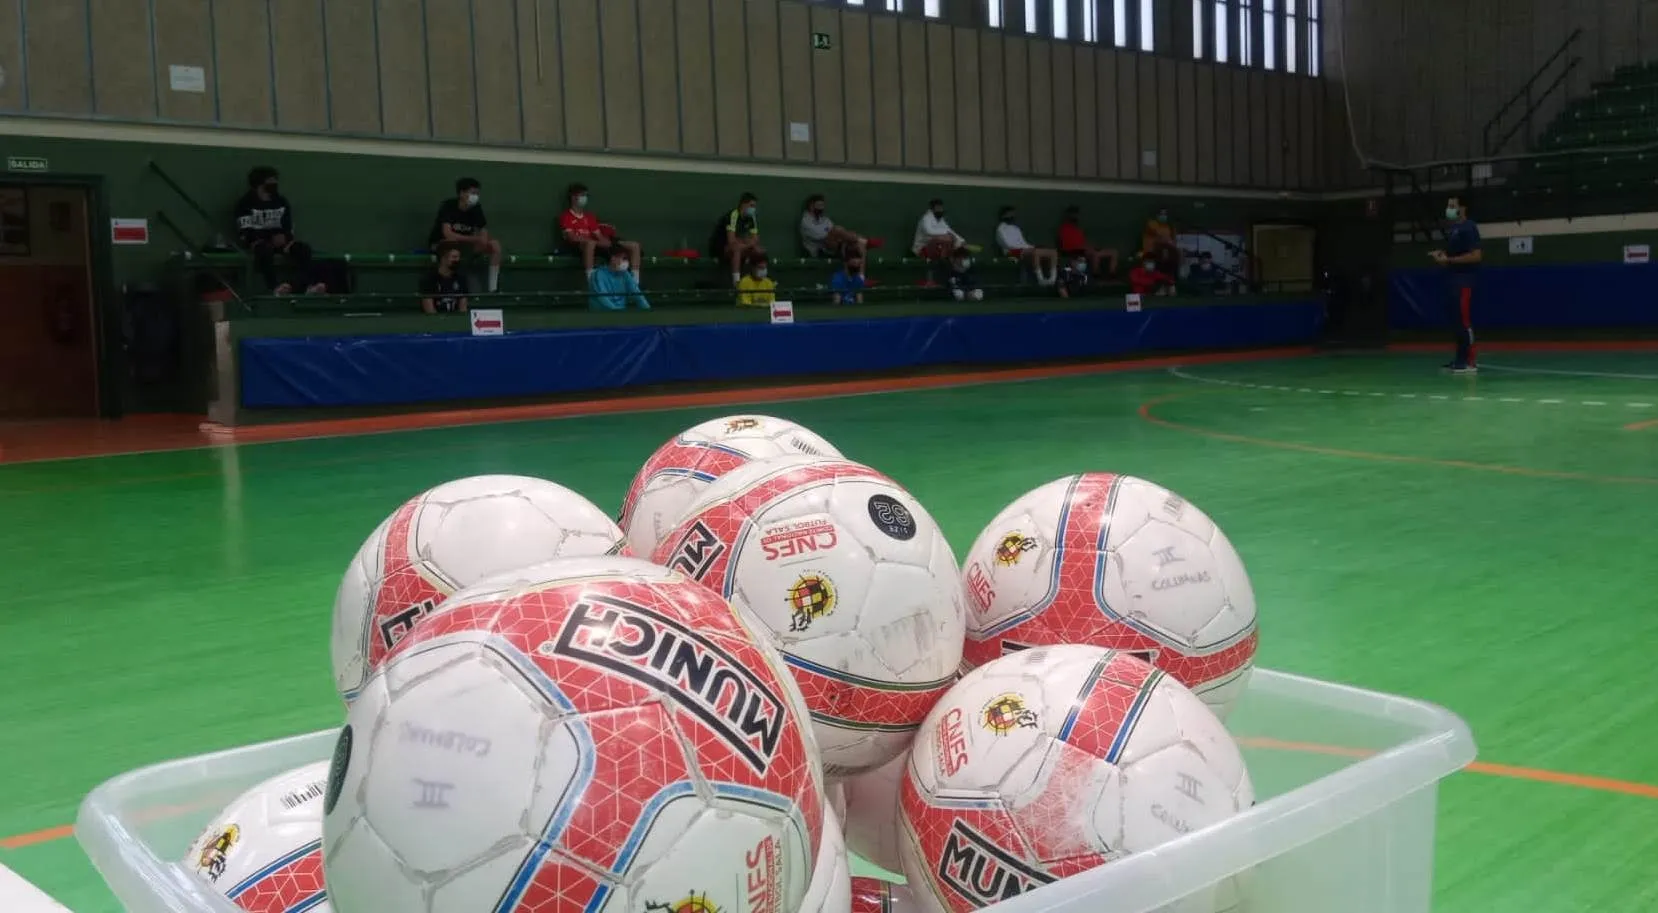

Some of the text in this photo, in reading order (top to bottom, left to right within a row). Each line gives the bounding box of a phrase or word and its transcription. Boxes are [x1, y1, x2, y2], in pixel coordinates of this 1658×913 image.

[764, 532, 838, 561] CNFS
[967, 562, 996, 612] CNFS
[554, 600, 785, 762] MUNICH
[945, 708, 969, 774] CNFS
[939, 831, 1040, 902] MUN
